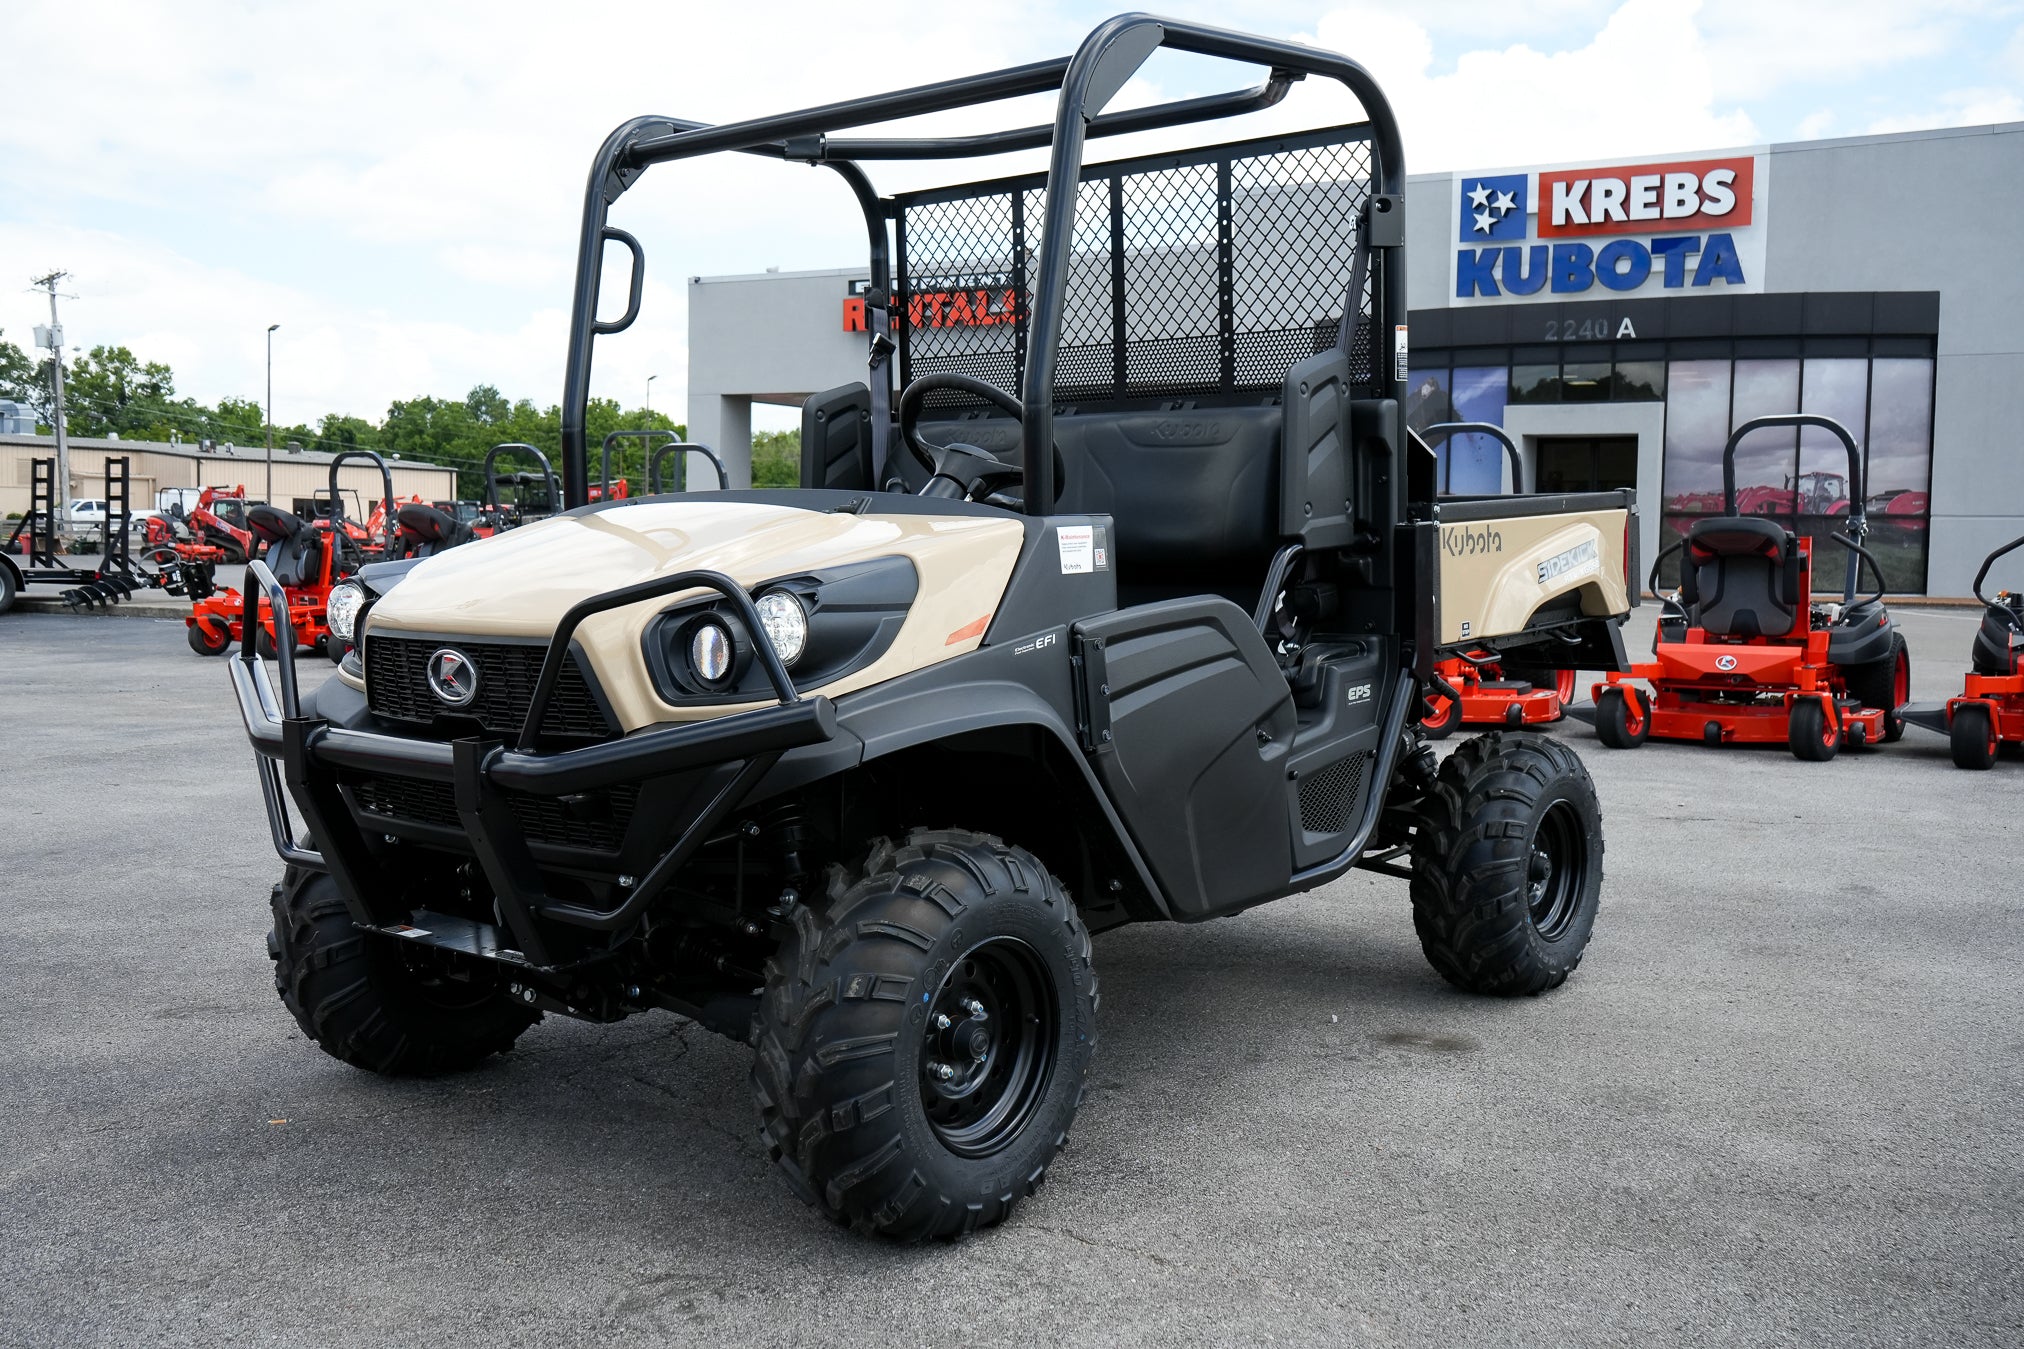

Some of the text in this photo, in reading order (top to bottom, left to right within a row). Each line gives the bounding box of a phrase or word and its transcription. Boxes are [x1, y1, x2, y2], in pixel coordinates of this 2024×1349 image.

[1551, 167, 1737, 226] KREBS
[1456, 233, 1746, 298] KUBOTA
[1544, 316, 1637, 341] 2240 A
[1442, 524, 1502, 556] Kubota
[1036, 633, 1056, 649] EFI
[1348, 684, 1371, 700] EPS
